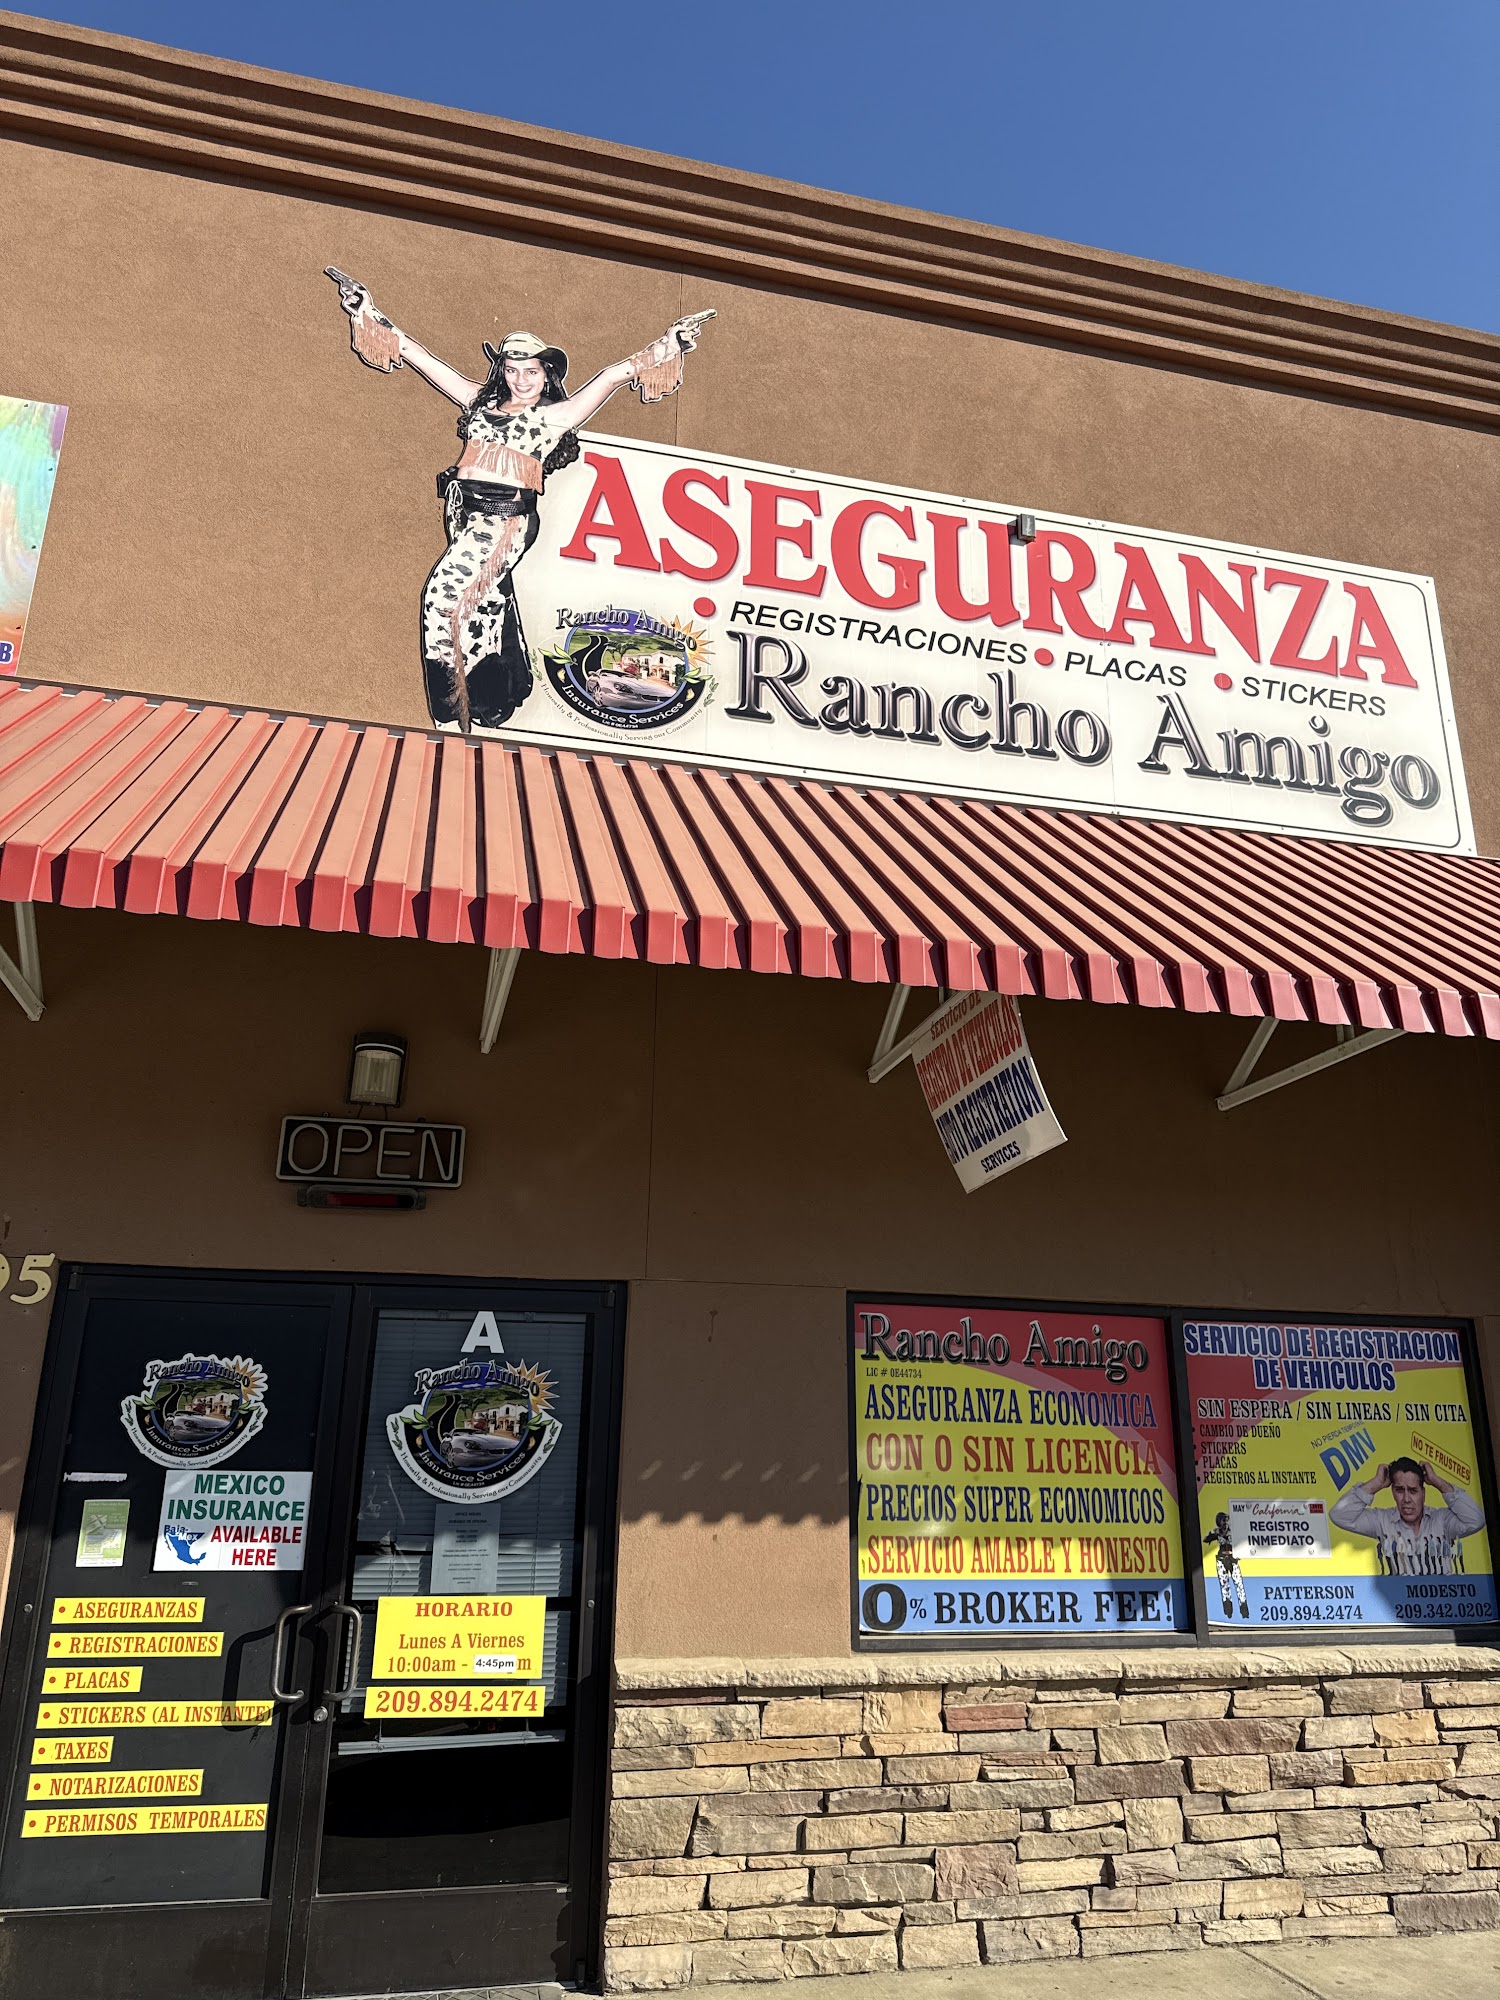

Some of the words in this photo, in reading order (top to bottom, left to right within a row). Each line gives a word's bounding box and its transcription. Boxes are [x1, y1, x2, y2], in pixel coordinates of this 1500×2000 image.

[560, 452, 1418, 688] ASEGURANZA
[556, 604, 629, 629] Rancho
[634, 609, 697, 650] Amigo
[730, 601, 1027, 664] REGISTRACIONES
[1064, 652, 1187, 686] PLACAS
[1242, 676, 1386, 717] STICKERS
[562, 684, 627, 723] Insurance
[629, 702, 684, 724] Services
[725, 630, 1112, 767] Rancho
[1137, 691, 1441, 827] Amigo
[930, 998, 967, 1040] SERVICIO
[969, 991, 982, 1010] DE
[954, 1056, 1045, 1152] REGISTRATION
[287, 1123, 457, 1181] OPEN
[980, 1141, 1021, 1173] SERVICES
[460, 1311, 504, 1353] A
[1184, 1323, 1281, 1357] SERVICIO
[1286, 1326, 1313, 1357] DE
[1315, 1328, 1460, 1362] REGISTRACION
[858, 1312, 1010, 1366] Rancho
[1022, 1319, 1149, 1384] Amigo
[148, 1357, 201, 1382] Rancho
[205, 1358, 251, 1387] Amigo
[415, 1358, 481, 1394] Rancho
[485, 1360, 539, 1397] Amigo
[866, 1367, 878, 1377] LIC
[1254, 1359, 1280, 1389] DE
[1283, 1360, 1396, 1391] VEHICULOS
[865, 1384, 1022, 1424] ASEGURANZA
[1028, 1389, 1157, 1428] ECONOMICA
[1198, 1399, 1225, 1418] SIN
[1230, 1400, 1293, 1419] ESPERA
[1306, 1402, 1332, 1420] SIN
[1336, 1402, 1391, 1421] LINEAS
[1406, 1403, 1430, 1421] SIN
[1435, 1404, 1467, 1422] CITA
[146, 1426, 191, 1453] Insurance
[192, 1430, 234, 1453] Services
[1200, 1425, 1235, 1437] CAMBIO
[1236, 1426, 1249, 1437] DE
[1251, 1422, 1281, 1438] DUEÑO
[1311, 1438, 1323, 1449] NO
[1322, 1429, 1343, 1443] PIERDA
[866, 1433, 923, 1472] CON
[964, 1435, 1014, 1473] SIN
[1025, 1437, 1162, 1475] LICENCIA
[1201, 1442, 1247, 1455] STICKERS
[1319, 1427, 1376, 1491] DMV
[1413, 1436, 1424, 1450] NO
[1424, 1442, 1434, 1458] TE
[1434, 1447, 1471, 1481] FRUSTRES
[419, 1449, 475, 1482] Insurance
[477, 1451, 526, 1482] Services
[1203, 1456, 1238, 1468] PLACAS
[194, 1474, 285, 1495] MEXICO
[400, 1452, 421, 1481] Honestly
[428, 1482, 471, 1500] Professionally
[472, 1491, 497, 1499] Serving
[509, 1456, 542, 1487] Community
[1203, 1471, 1256, 1484] REGISTROS
[1258, 1471, 1270, 1484] AL
[1272, 1471, 1317, 1484] INSTANTE
[167, 1500, 305, 1521] INSURANCE
[866, 1484, 956, 1521] PRECIOS
[964, 1484, 1033, 1523] SUPER
[1040, 1487, 1165, 1524] ECONOMICOS
[1232, 1504, 1245, 1512] MAY
[1252, 1503, 1304, 1519] California
[178, 1532, 198, 1541] Mex
[210, 1525, 303, 1544] AVAILABLE
[1249, 1521, 1309, 1531] REGISTRO
[1248, 1535, 1314, 1546] INMEDIATO
[231, 1548, 277, 1566] HERE
[868, 1534, 964, 1574] SERVICIO
[971, 1536, 1053, 1573] AMABLE
[1060, 1537, 1076, 1573] Y
[1079, 1536, 1169, 1574] HONESTO
[1264, 1585, 1355, 1600] PATTERSON
[1406, 1583, 1476, 1598] MODESTO
[73, 1602, 198, 1618] ASEGURANZAS
[415, 1602, 513, 1617] HORARIO
[934, 1591, 1082, 1625] BROKER
[1093, 1590, 1172, 1622] FEE!
[1260, 1605, 1363, 1621] 209.894.2474
[1395, 1602, 1492, 1619] 209.342.0202
[69, 1636, 218, 1653] REGISTRACIONES
[399, 1634, 446, 1649] Lunes
[451, 1633, 462, 1649] A
[468, 1633, 525, 1649] Viernes
[388, 1656, 456, 1673] 10:00am
[475, 1659, 514, 1669] 4:45pm
[64, 1671, 130, 1689] PLACAS
[376, 1690, 538, 1713] 209.894.2474
[58, 1706, 146, 1724] STICKERS
[152, 1706, 179, 1724] (AL
[184, 1705, 272, 1723] INSTANTE)
[54, 1742, 108, 1760] TAXES
[49, 1774, 199, 1795] NOTARIZACIONES
[44, 1812, 138, 1833] PERMISOS
[149, 1809, 265, 1829] TEMPORALES
